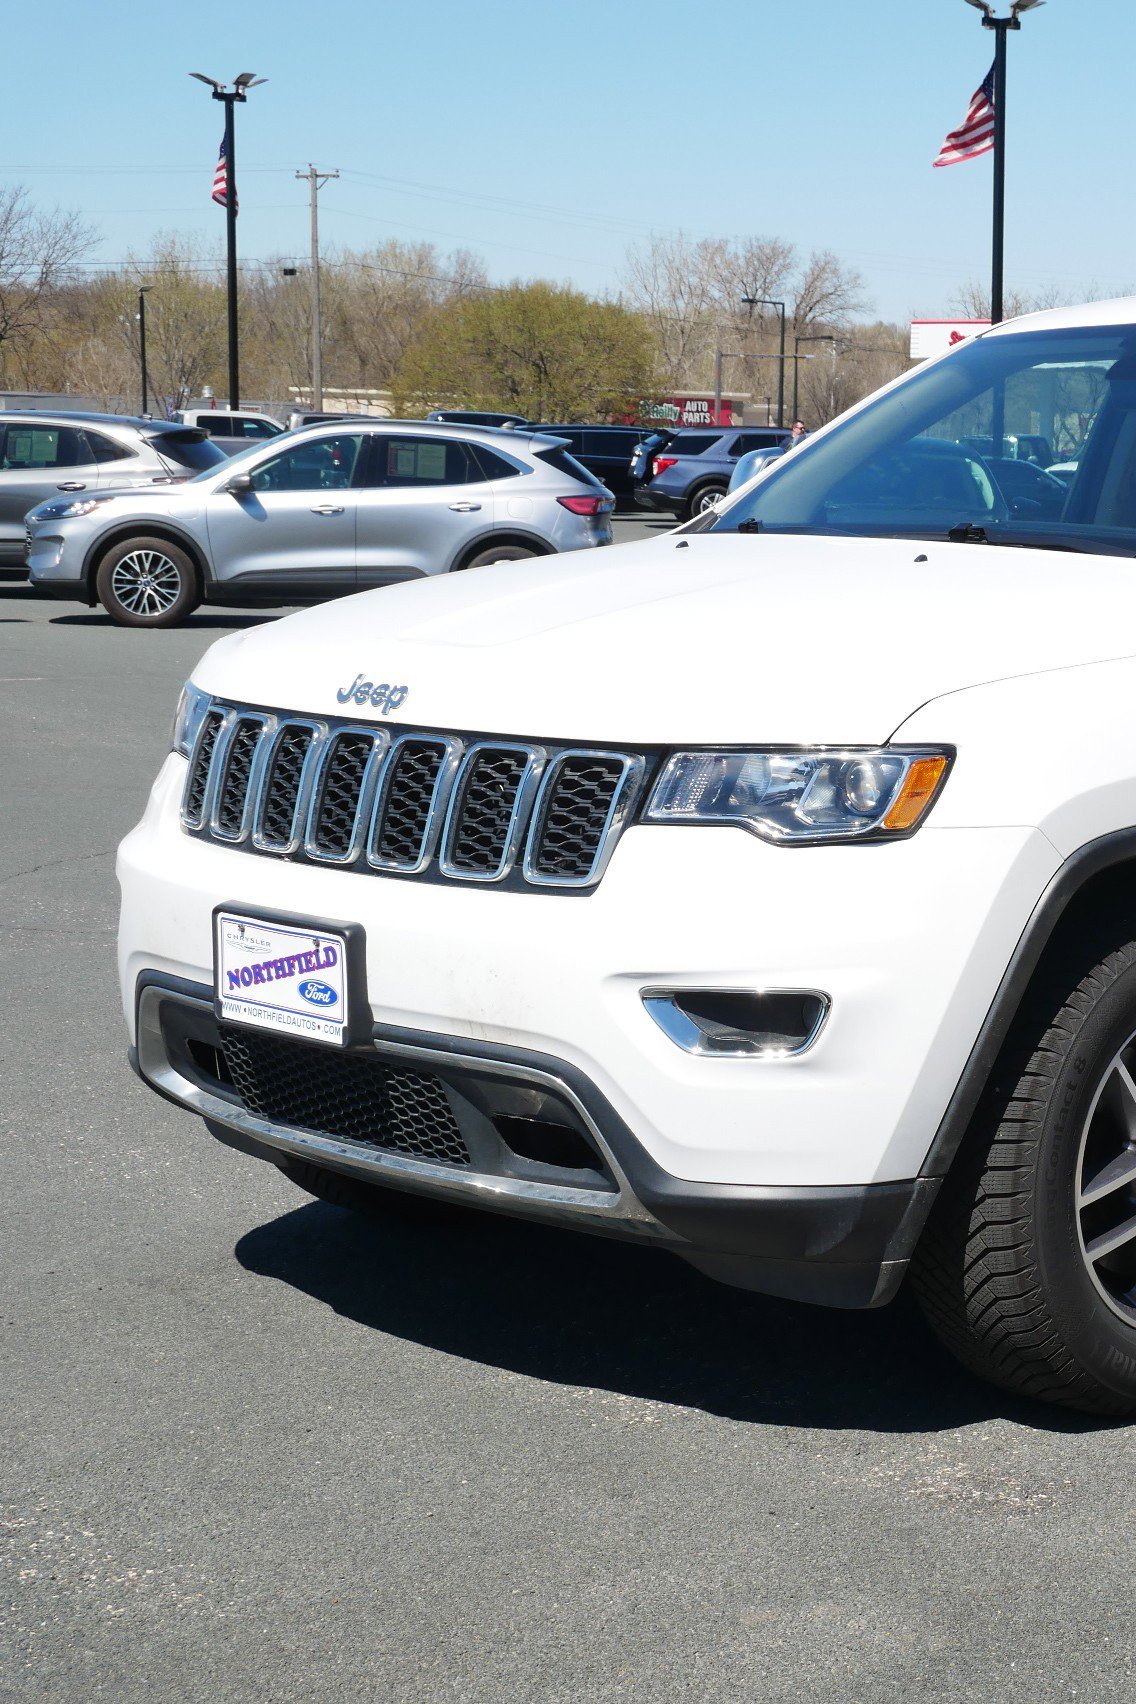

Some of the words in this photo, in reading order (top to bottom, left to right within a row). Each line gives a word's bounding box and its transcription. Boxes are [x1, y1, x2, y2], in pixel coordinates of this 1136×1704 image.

[685, 401, 708, 412] AUTO
[682, 412, 710, 423] PARTS
[337, 674, 408, 715] Jeep
[226, 933, 271, 948] CHRYSLER
[227, 946, 337, 990] NORTHFIELD
[305, 983, 331, 1003] Ford
